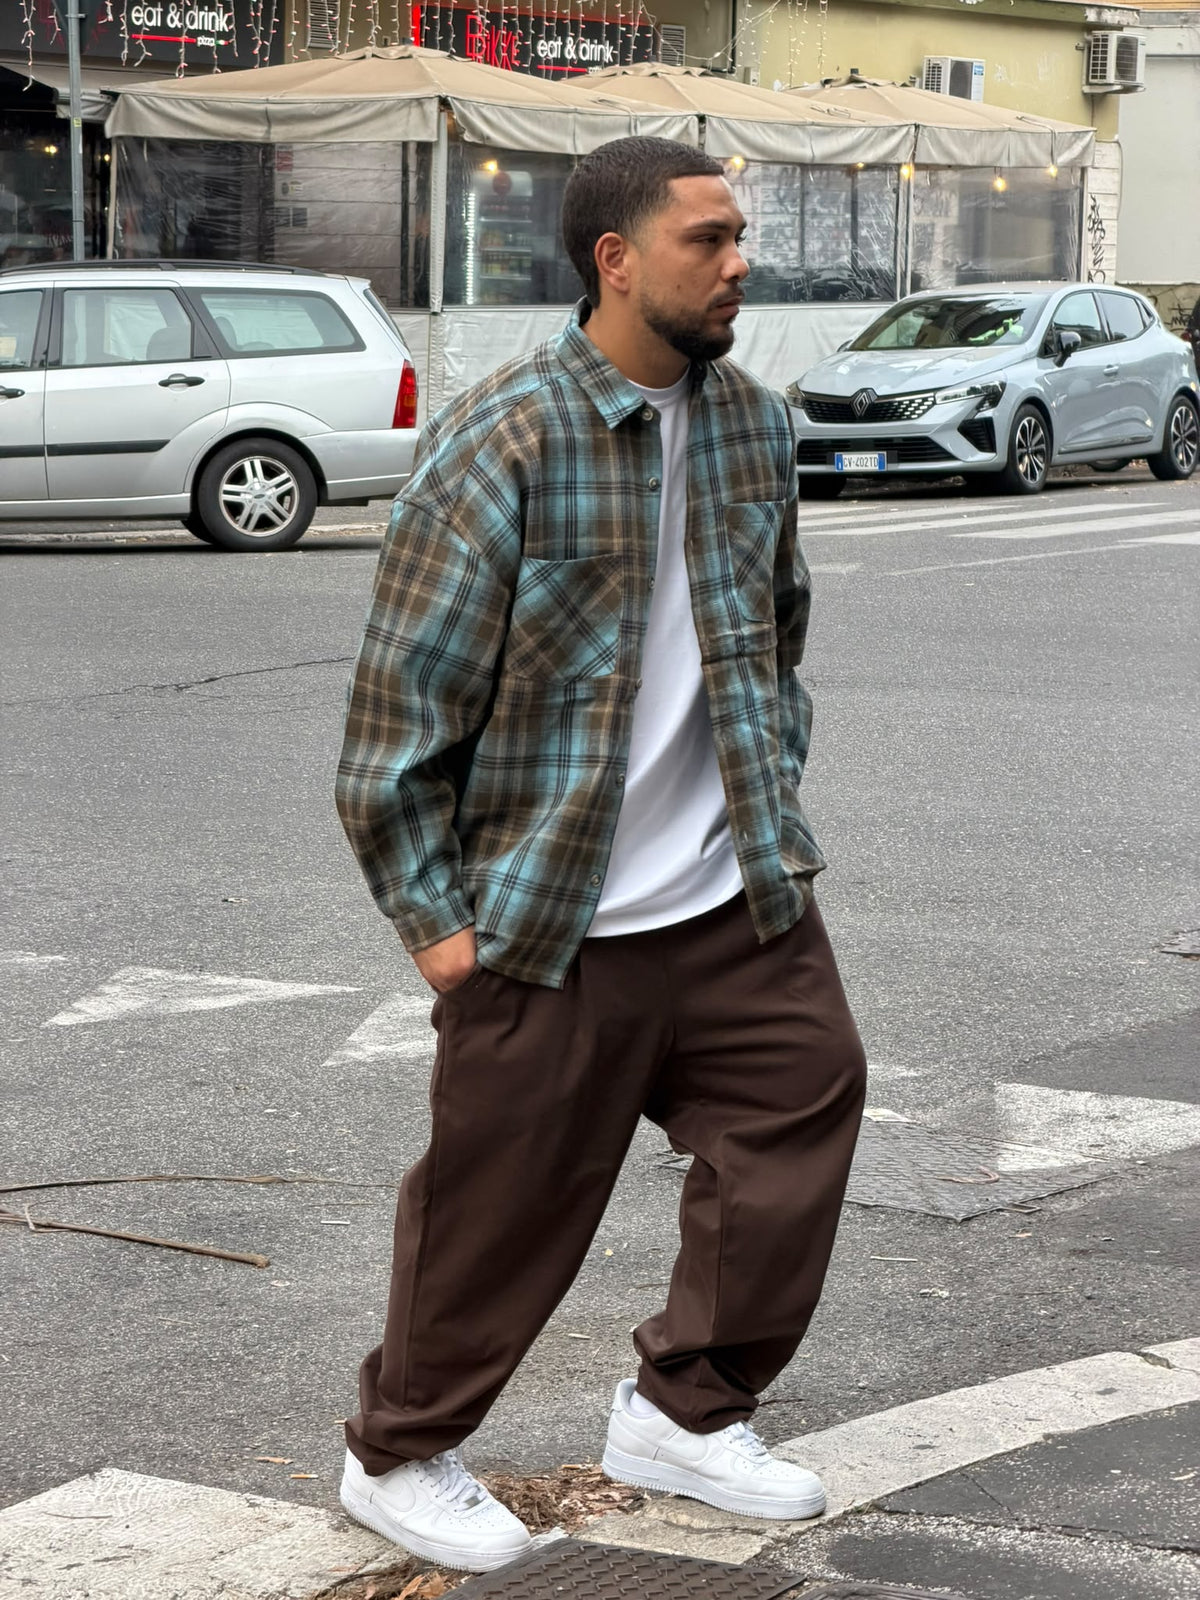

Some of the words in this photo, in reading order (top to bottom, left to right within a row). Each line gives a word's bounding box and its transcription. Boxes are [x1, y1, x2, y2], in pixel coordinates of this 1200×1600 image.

[131, 2, 163, 27] eat
[166, 3, 182, 29] &
[185, 5, 230, 32] drink
[197, 35, 215, 47] pizza
[537, 36, 563, 59] eat
[564, 36, 577, 60] &
[579, 38, 614, 63] drink
